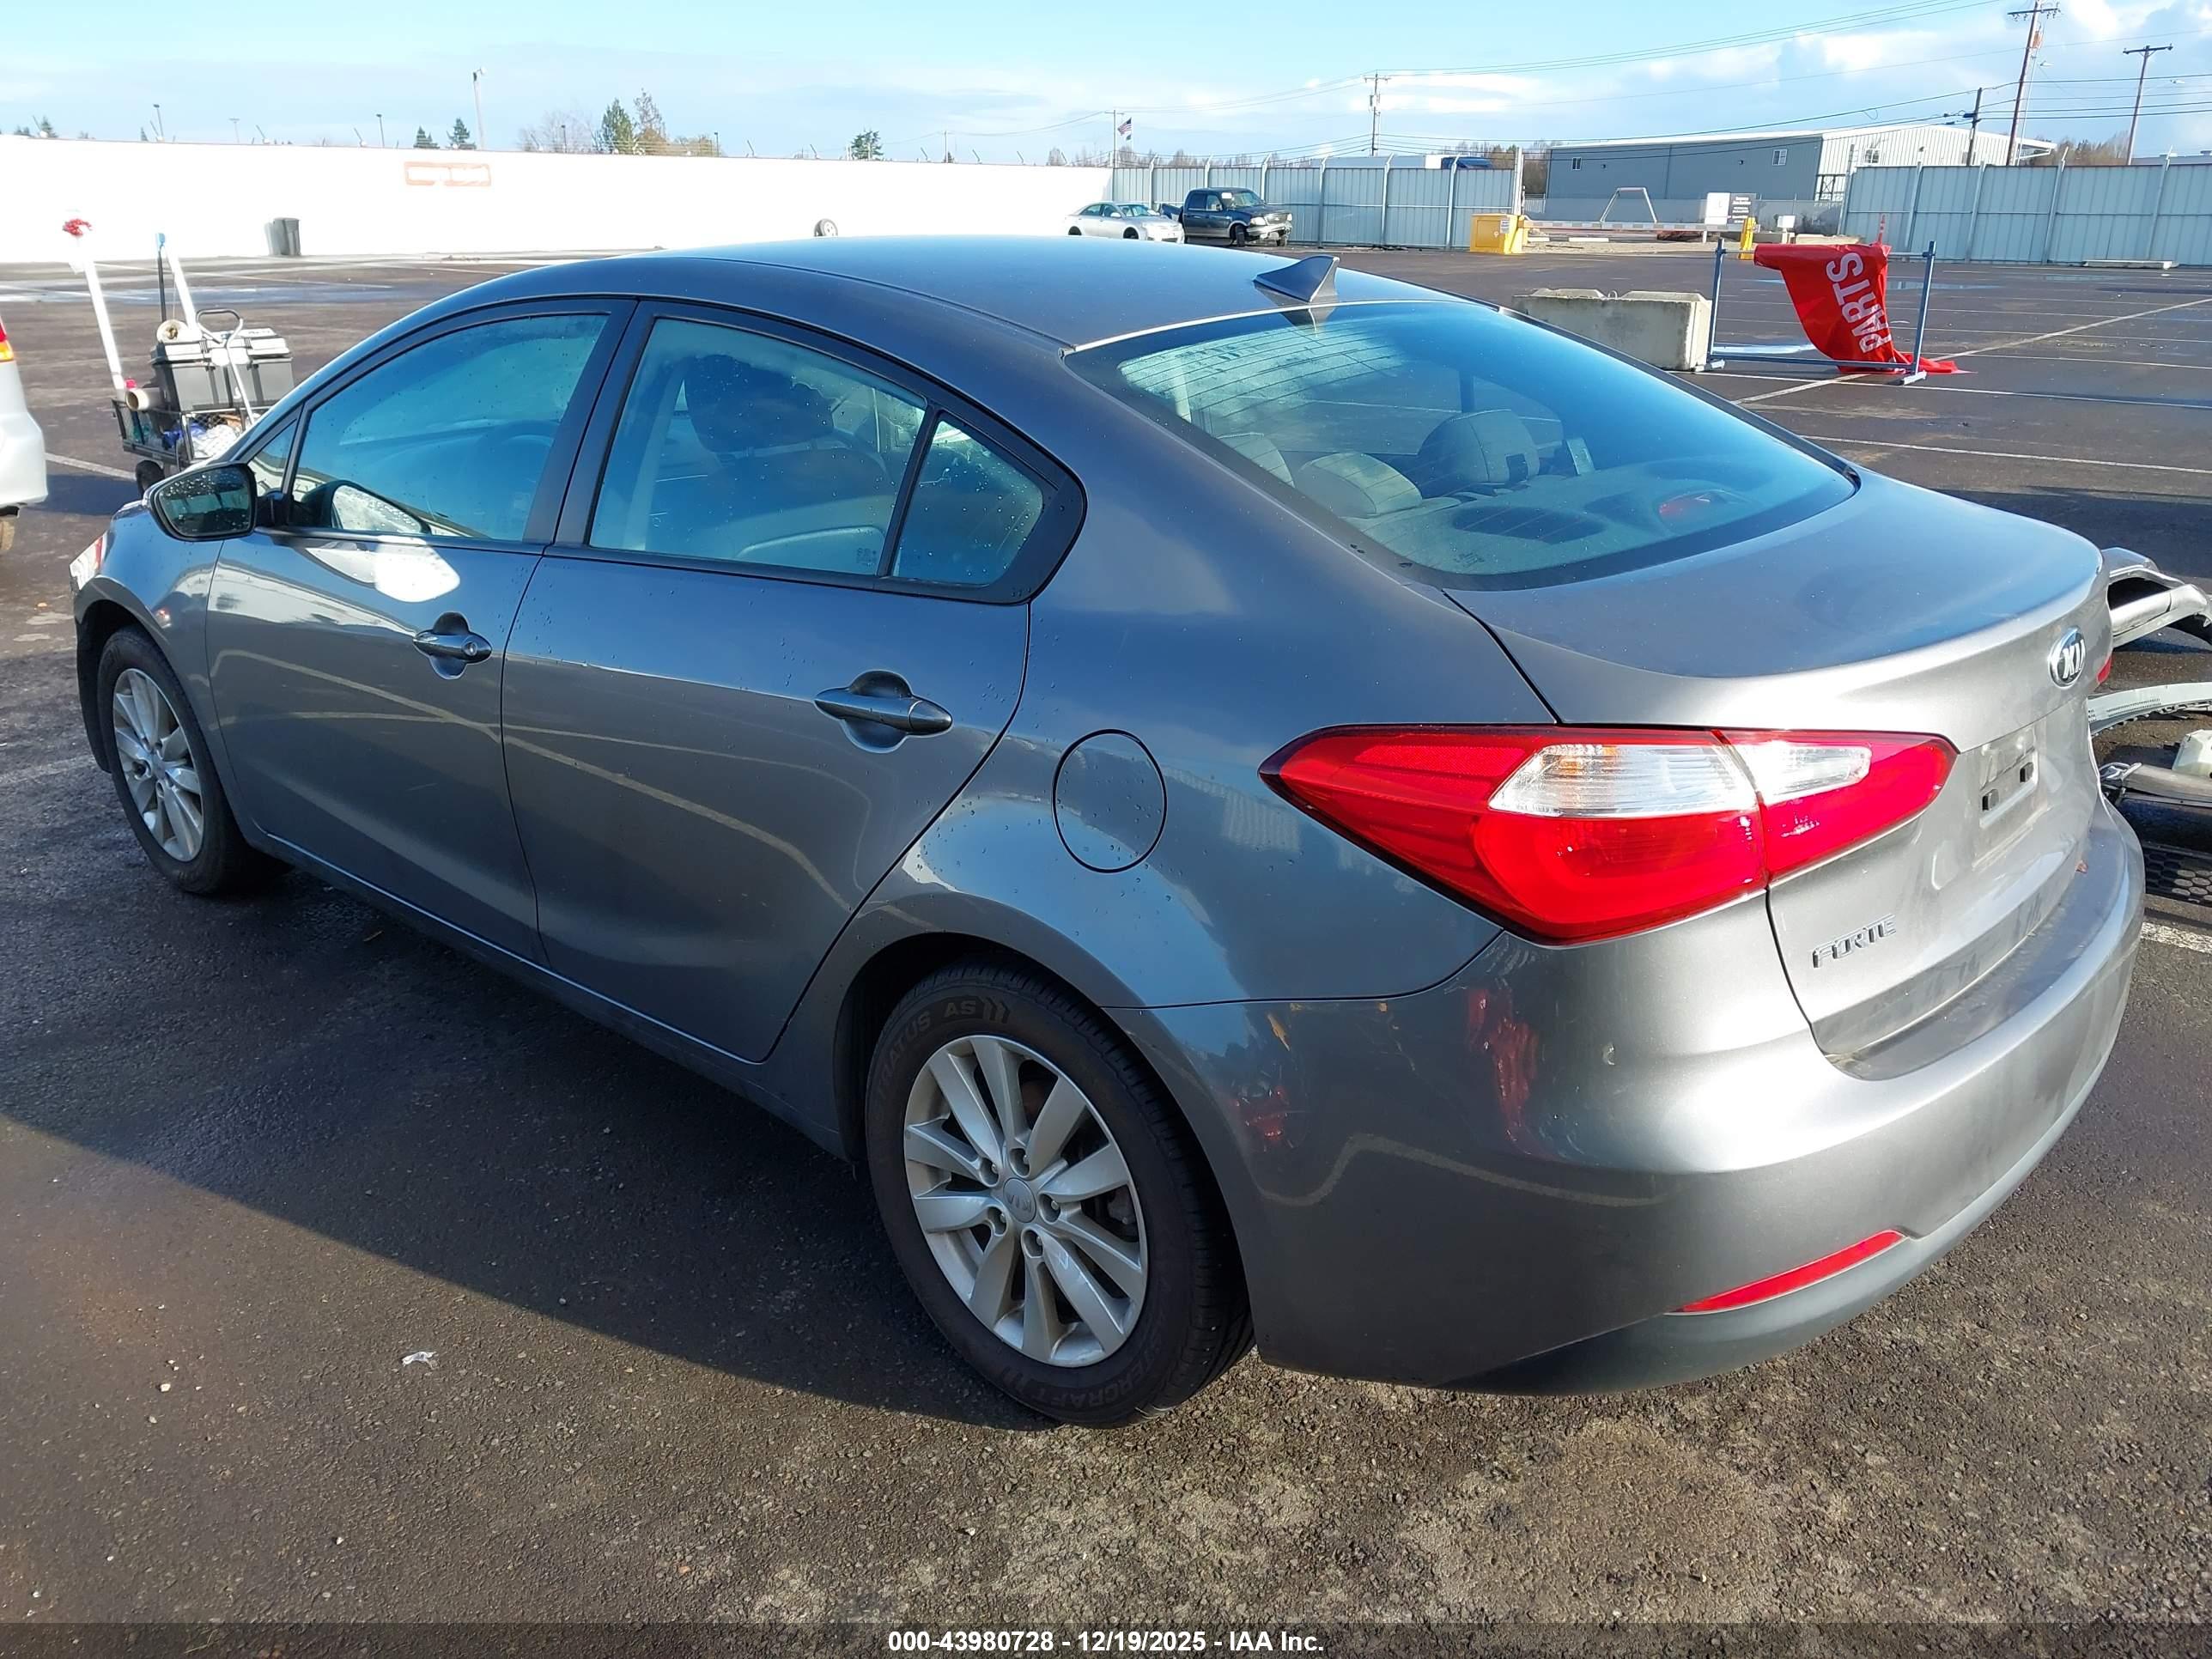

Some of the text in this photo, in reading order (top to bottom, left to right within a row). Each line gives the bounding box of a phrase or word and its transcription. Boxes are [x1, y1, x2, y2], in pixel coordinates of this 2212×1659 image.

[1826, 252, 1893, 354] PARTS
[1812, 913, 1897, 969] FORTE
[944, 1000, 976, 1018] AS
